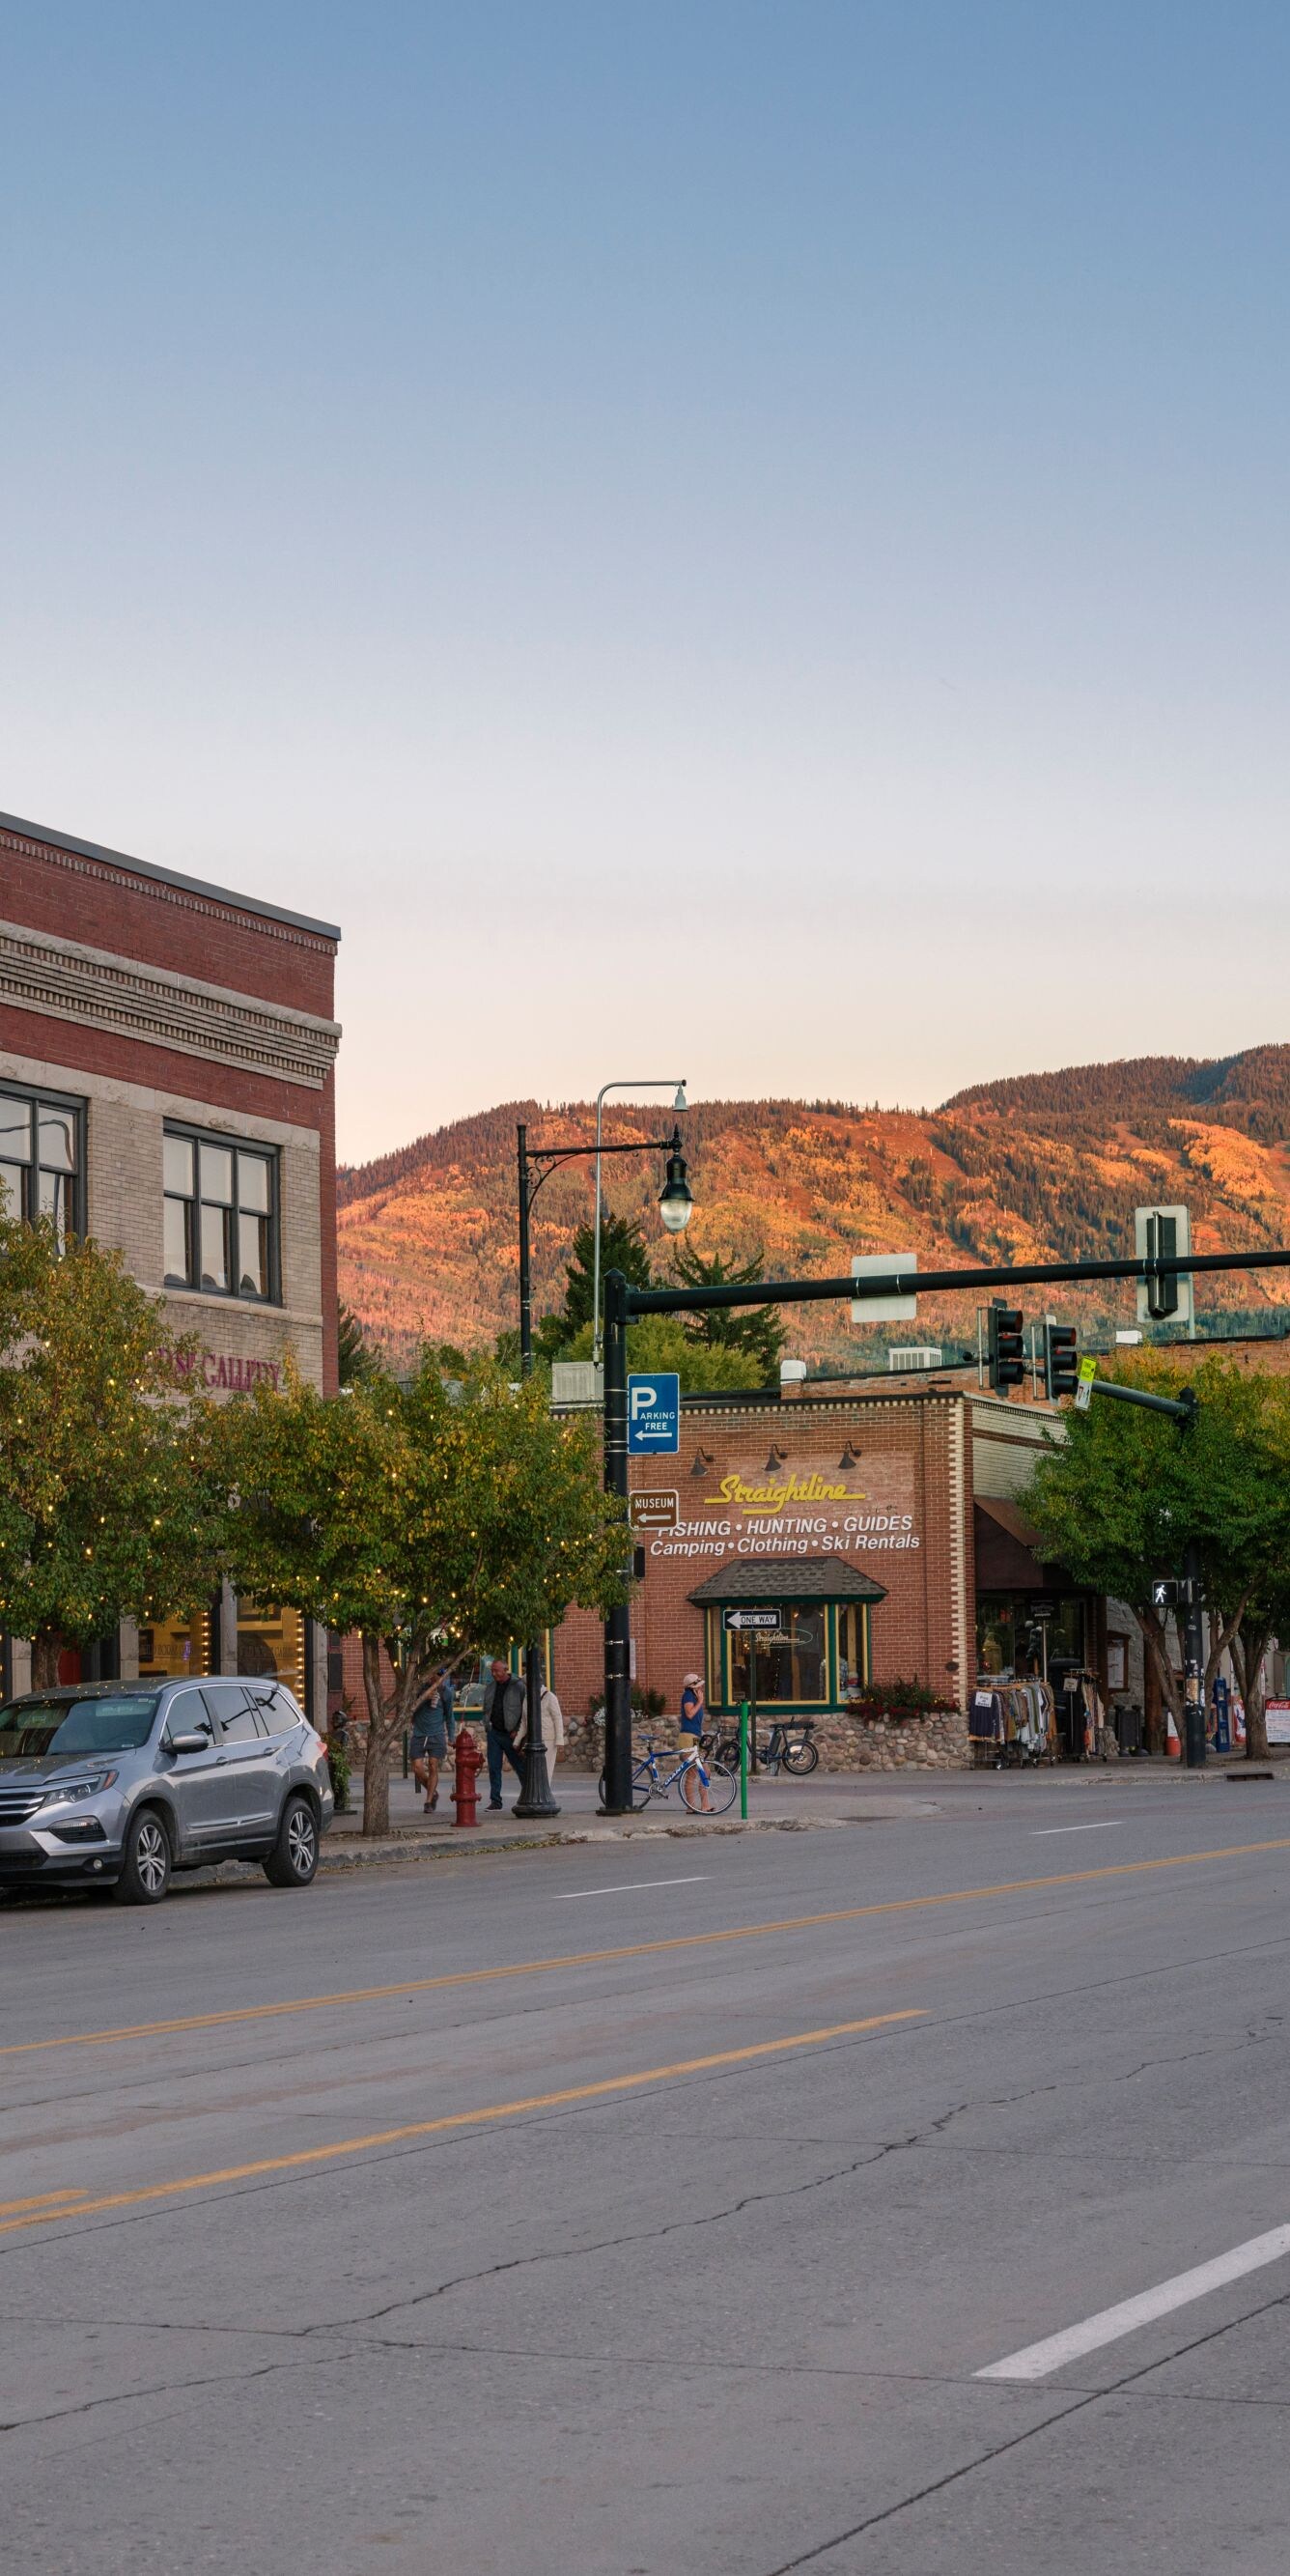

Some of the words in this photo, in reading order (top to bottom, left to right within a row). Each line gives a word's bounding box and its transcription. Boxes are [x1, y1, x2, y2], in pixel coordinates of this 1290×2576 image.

[631, 1387, 675, 1421] PARKING
[645, 1422, 667, 1430] FREE
[634, 1498, 674, 1509] MUSEUM
[704, 1474, 866, 1514] Straightline
[746, 1517, 827, 1535] HUNTING
[843, 1514, 912, 1532] GUIDES
[650, 1540, 725, 1557] Camping
[737, 1537, 808, 1554] Clothing
[821, 1535, 850, 1550] Ski
[855, 1533, 920, 1549] Rentals
[741, 1616, 756, 1625] ONE
